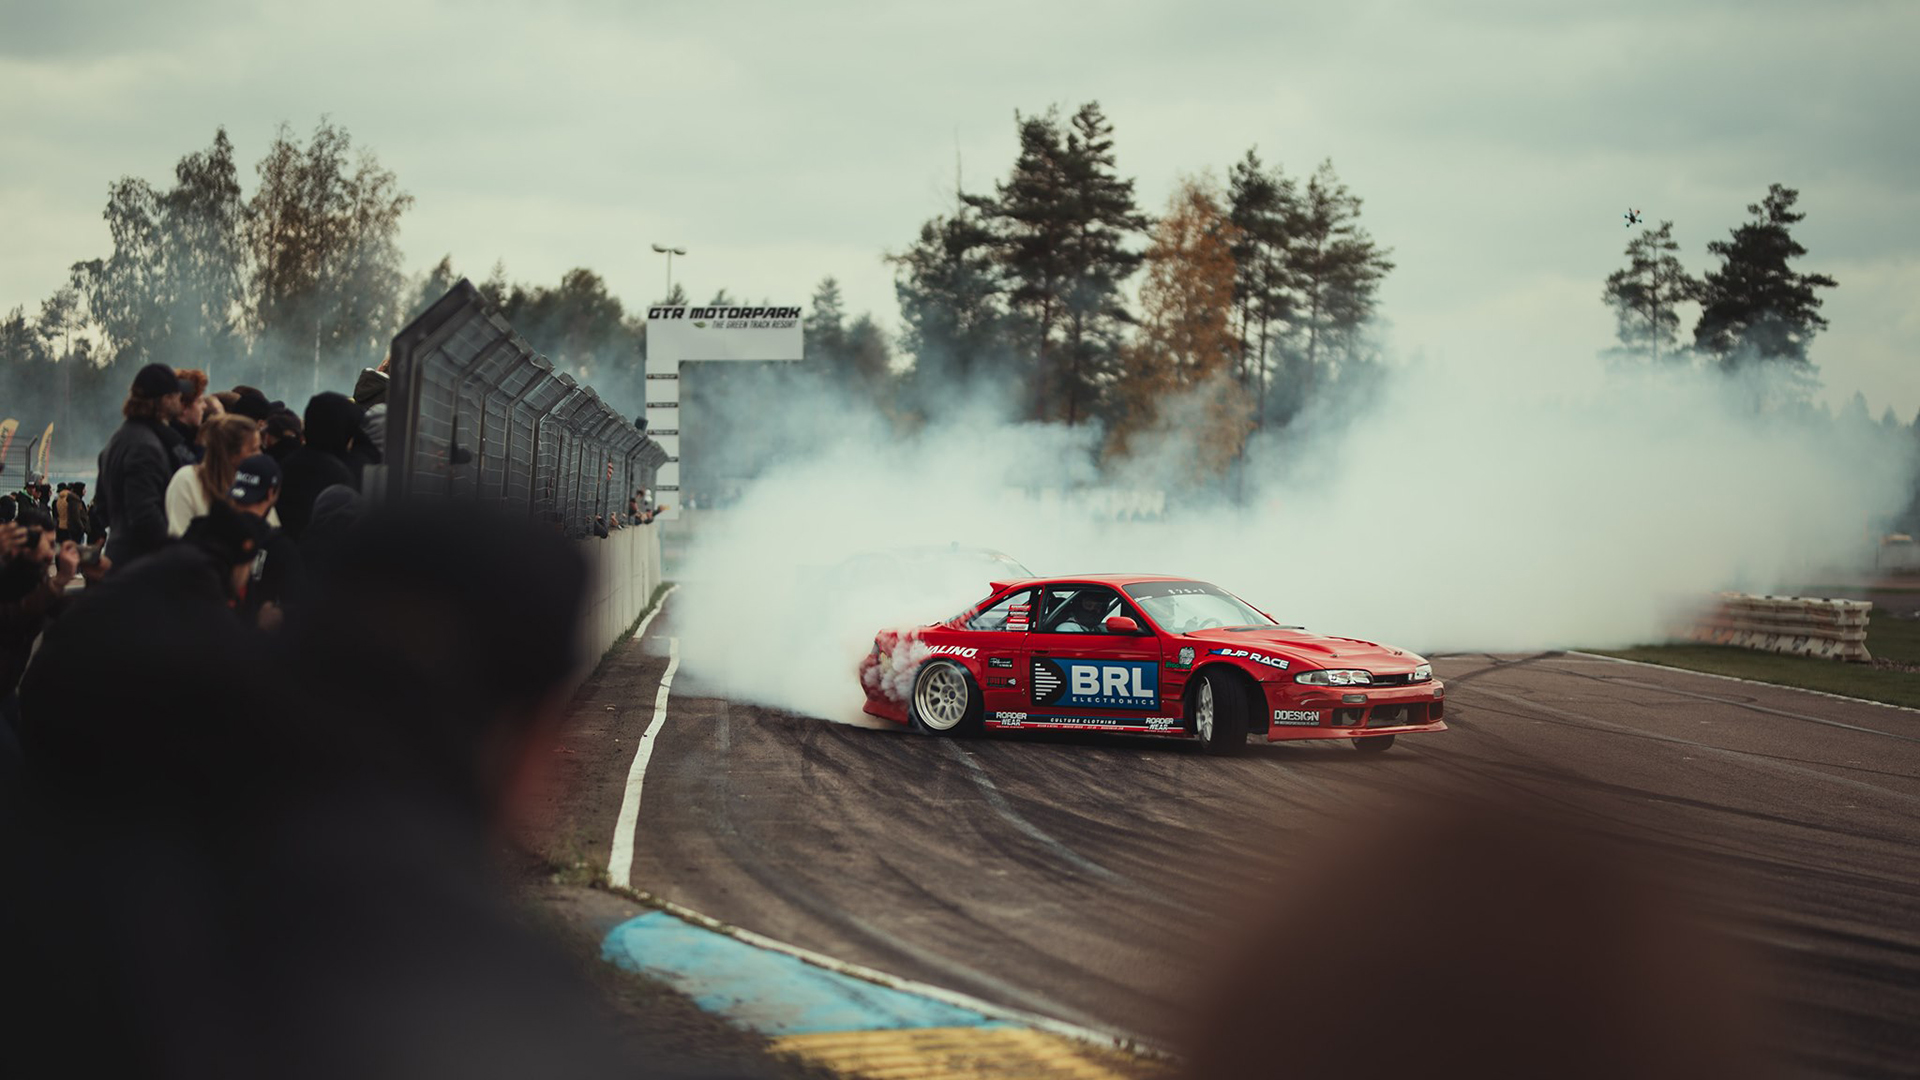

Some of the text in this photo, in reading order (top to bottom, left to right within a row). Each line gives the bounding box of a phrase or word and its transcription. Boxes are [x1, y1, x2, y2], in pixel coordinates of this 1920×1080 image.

[648, 307, 801, 319] GTR MOTORPARK
[712, 320, 798, 329] THE GREEN TRACK RESORT
[1221, 648, 1290, 670] BJP RACE
[1071, 665, 1154, 698] BRL
[1072, 697, 1155, 705] ELECTRONICS
[1274, 710, 1320, 721] DDESIGN
